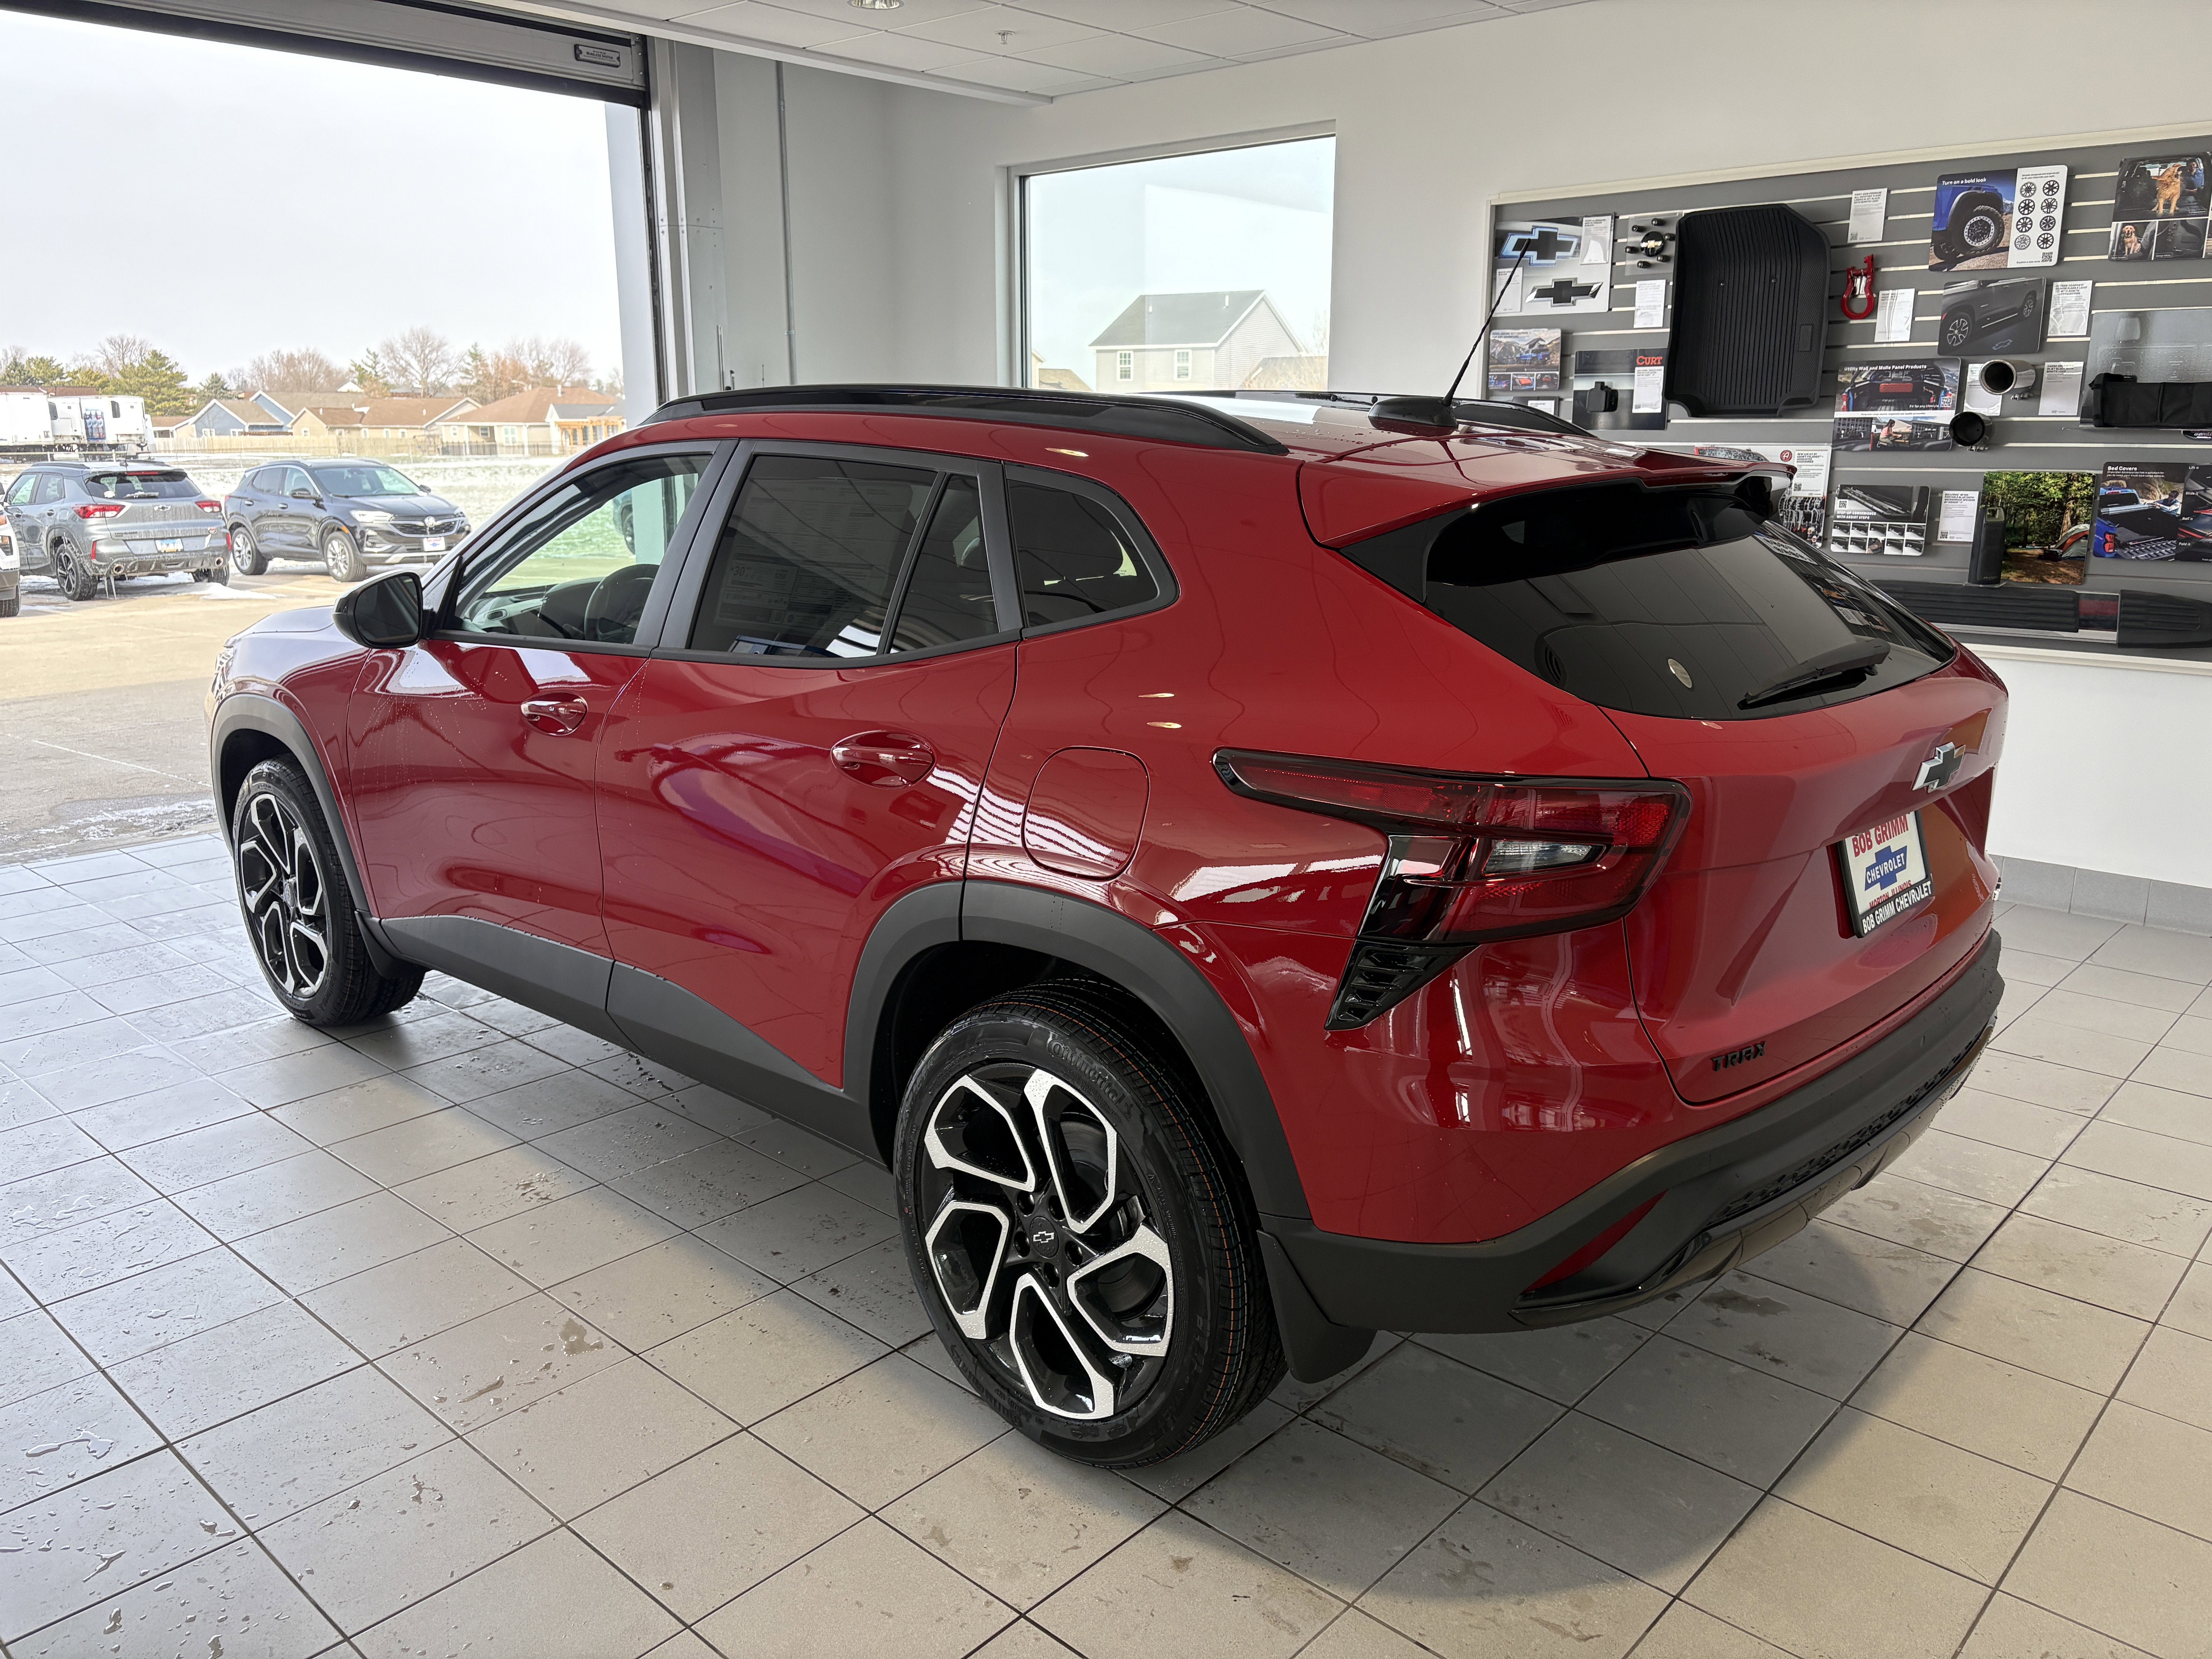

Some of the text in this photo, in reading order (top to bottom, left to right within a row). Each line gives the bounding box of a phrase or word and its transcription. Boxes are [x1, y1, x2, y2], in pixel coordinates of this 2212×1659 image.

[1636, 356, 1663, 365] CURT
[1852, 814, 1909, 858] BOB GRIMM
[1866, 853, 1905, 884] CHEVROLET
[1862, 880, 1932, 934] BOB GRIMM CHEVROLET
[1869, 879, 1912, 910] MORTON ILLINOIS
[1046, 1039, 1126, 1104] Continental
[1710, 1040, 1767, 1072] TRAX
